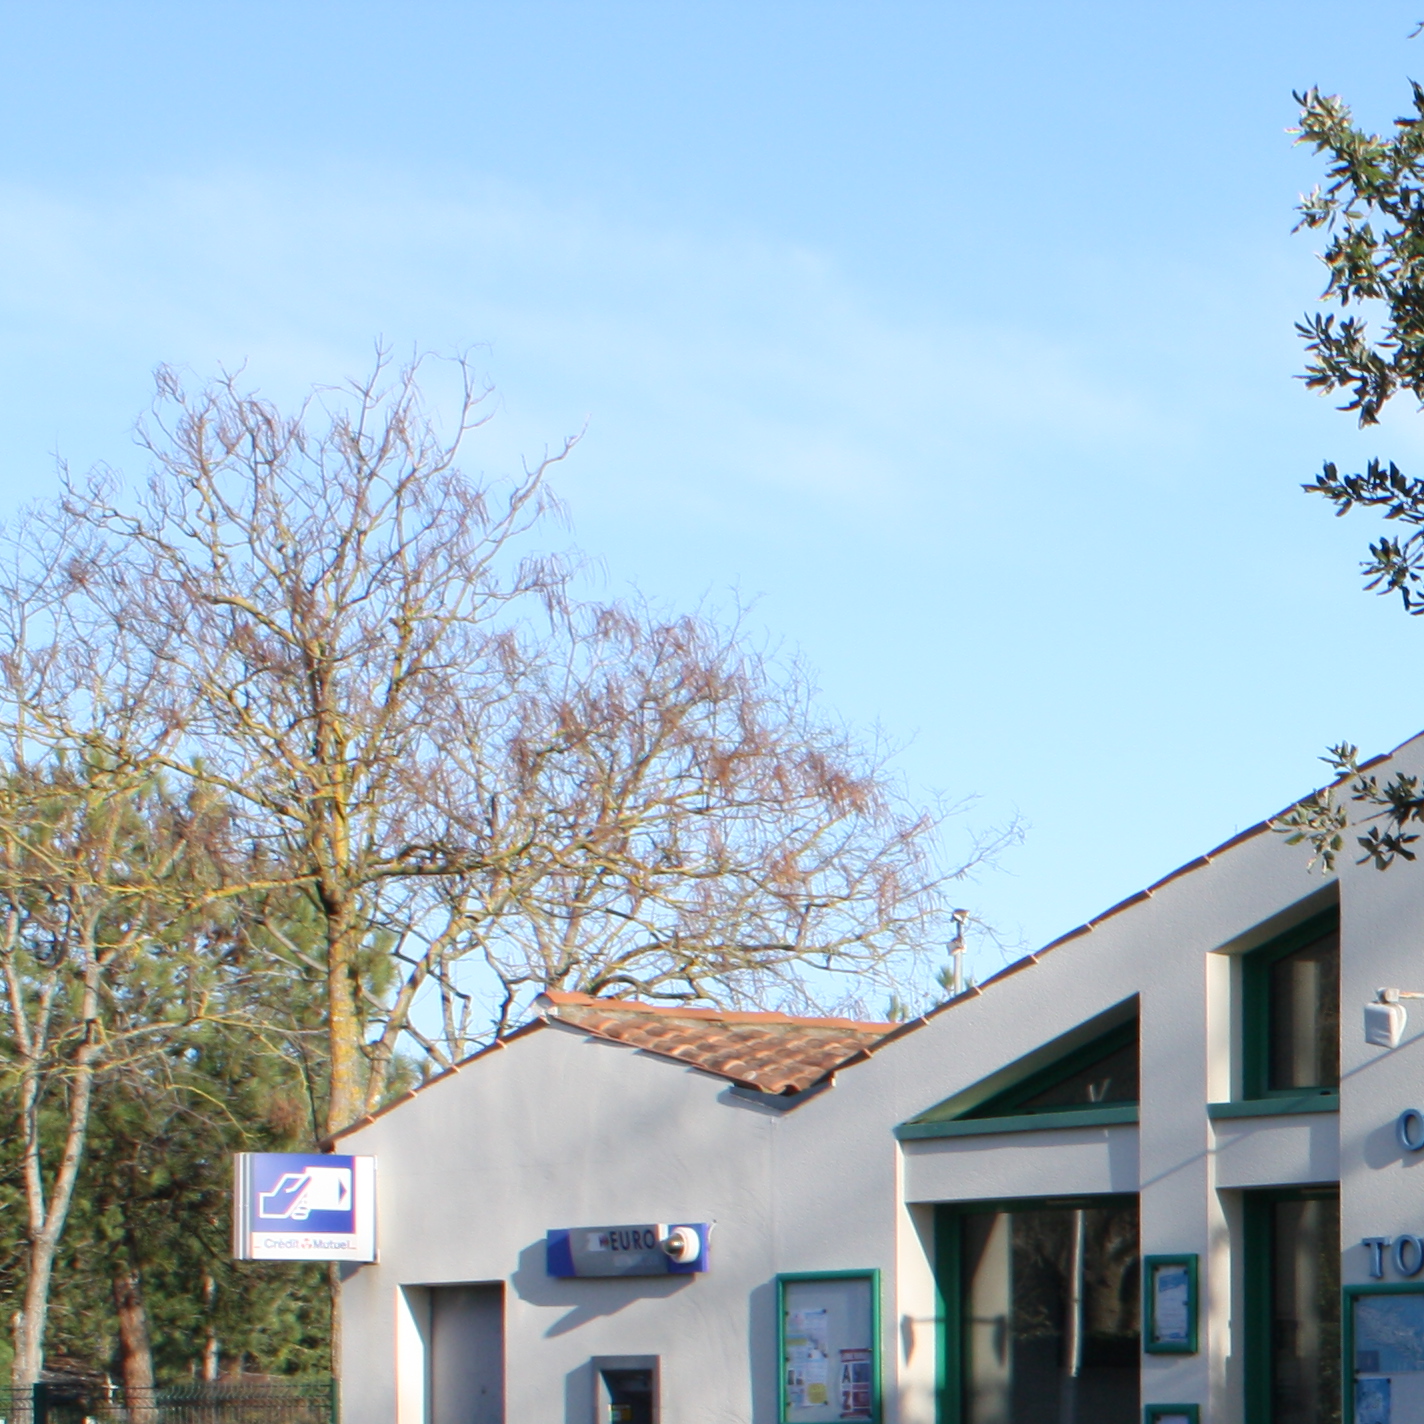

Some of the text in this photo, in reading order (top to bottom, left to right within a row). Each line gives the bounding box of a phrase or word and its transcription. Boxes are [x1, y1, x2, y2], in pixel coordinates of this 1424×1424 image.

[263, 1238, 351, 1250] Crédit Mutuel
[609, 1230, 655, 1251] EURO
